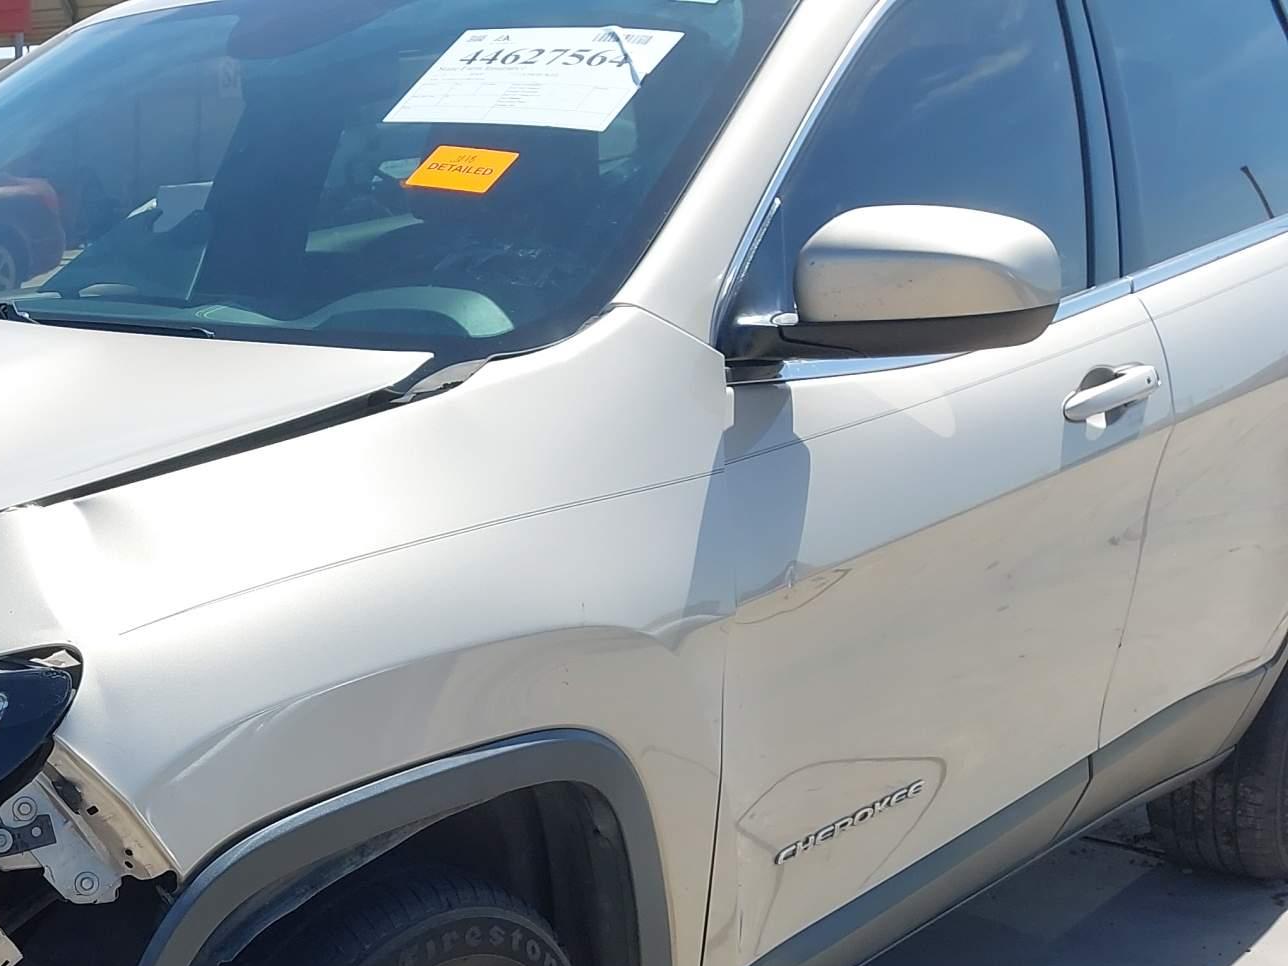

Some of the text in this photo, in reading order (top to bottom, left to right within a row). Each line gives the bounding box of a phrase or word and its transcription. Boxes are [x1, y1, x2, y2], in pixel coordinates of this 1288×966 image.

[459, 48, 630, 68] 44627564
[427, 162, 494, 176] DETAILED
[773, 777, 926, 866] CHEROKEE
